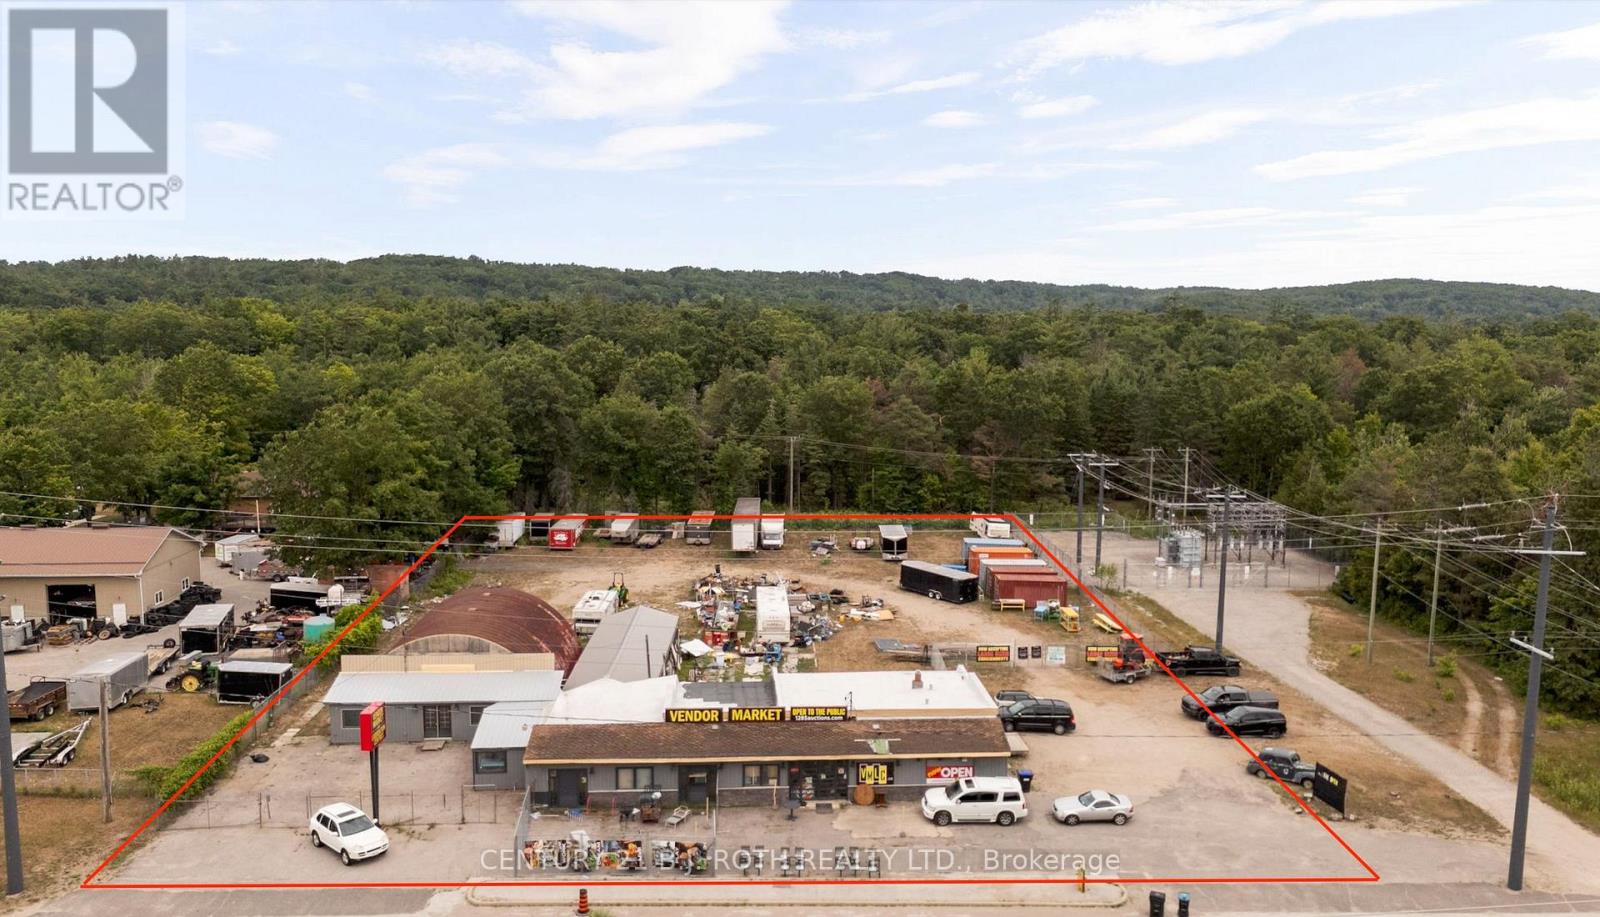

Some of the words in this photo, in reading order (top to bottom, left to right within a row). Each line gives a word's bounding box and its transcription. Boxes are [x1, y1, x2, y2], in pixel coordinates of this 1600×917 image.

[669, 709, 719, 722] VENDOR
[731, 708, 783, 721] MARKET
[792, 708, 806, 716] OPEN
[808, 708, 815, 716] TO
[816, 708, 826, 716] THE
[827, 708, 846, 716] PUBLIC
[941, 767, 973, 778] OPEN
